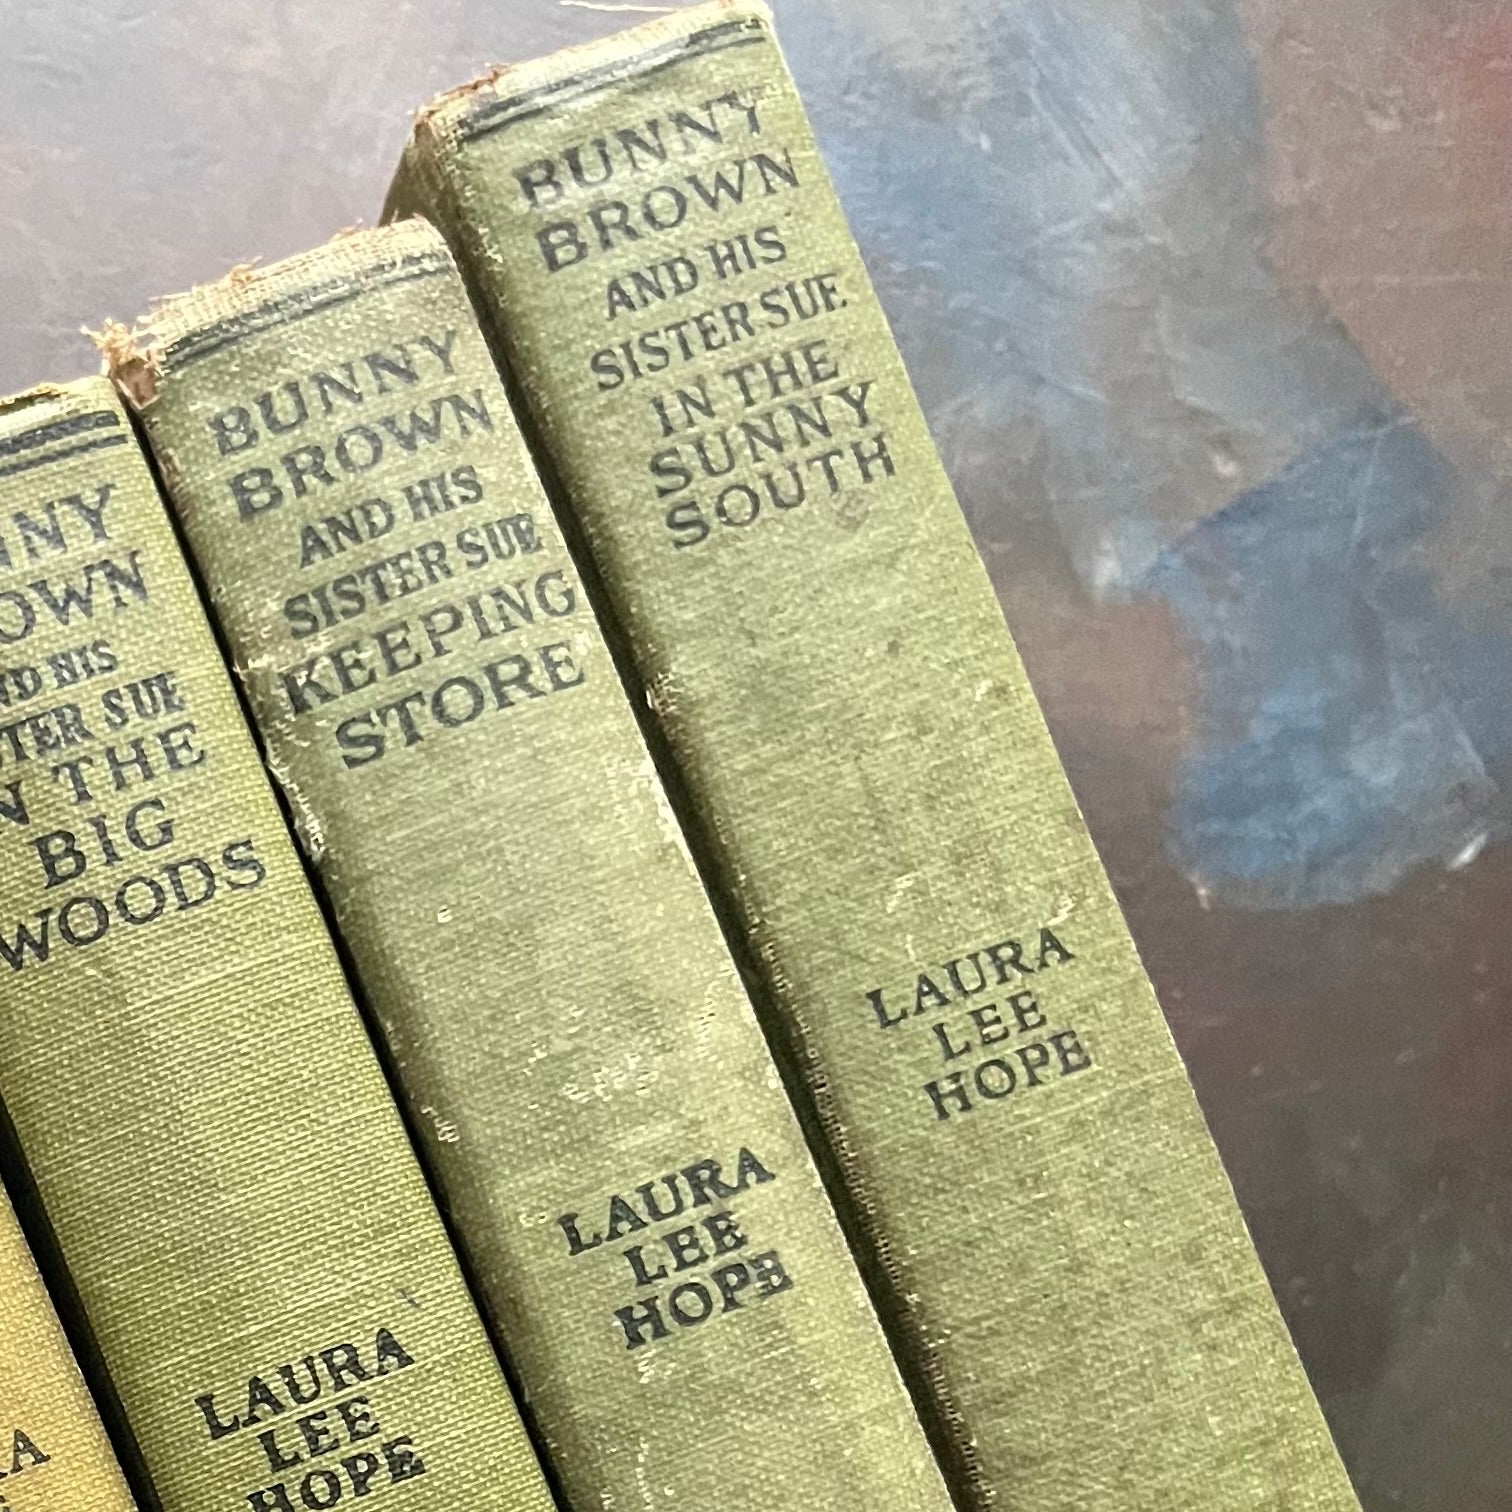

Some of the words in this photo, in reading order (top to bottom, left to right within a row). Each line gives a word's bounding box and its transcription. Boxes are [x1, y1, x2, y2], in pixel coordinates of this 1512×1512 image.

[511, 87, 765, 209] BUNNY
[535, 148, 800, 273] BROWN
[606, 255, 699, 321] AND
[705, 225, 787, 282] HIS
[591, 301, 755, 393] SISTER
[759, 273, 847, 330] SUE
[208, 330, 461, 456] BUNNY
[649, 380, 877, 498] SUNNY
[652, 374, 713, 438] IN
[722, 339, 841, 409] THE
[228, 389, 494, 520] BROWN
[666, 432, 897, 551] SOUTH
[299, 499, 395, 569] AND
[402, 466, 484, 521] HIS
[283, 541, 452, 639] SISTER
[456, 513, 542, 569] SUE
[47, 640, 118, 690] HIS
[283, 569, 576, 714] KEEPING
[105, 672, 185, 731] SUE
[335, 639, 585, 769] STORE
[52, 723, 206, 805] THE
[29, 797, 177, 890] BIG
[866, 927, 1077, 1028] LAURA
[932, 991, 1046, 1060] LEE
[923, 1030, 1092, 1120] HOPE
[557, 1147, 776, 1256] LAURA
[623, 1211, 748, 1288] LEE
[613, 1251, 794, 1350] HOPE
[194, 1327, 415, 1440] LAURA
[257, 1396, 380, 1474] LEE
